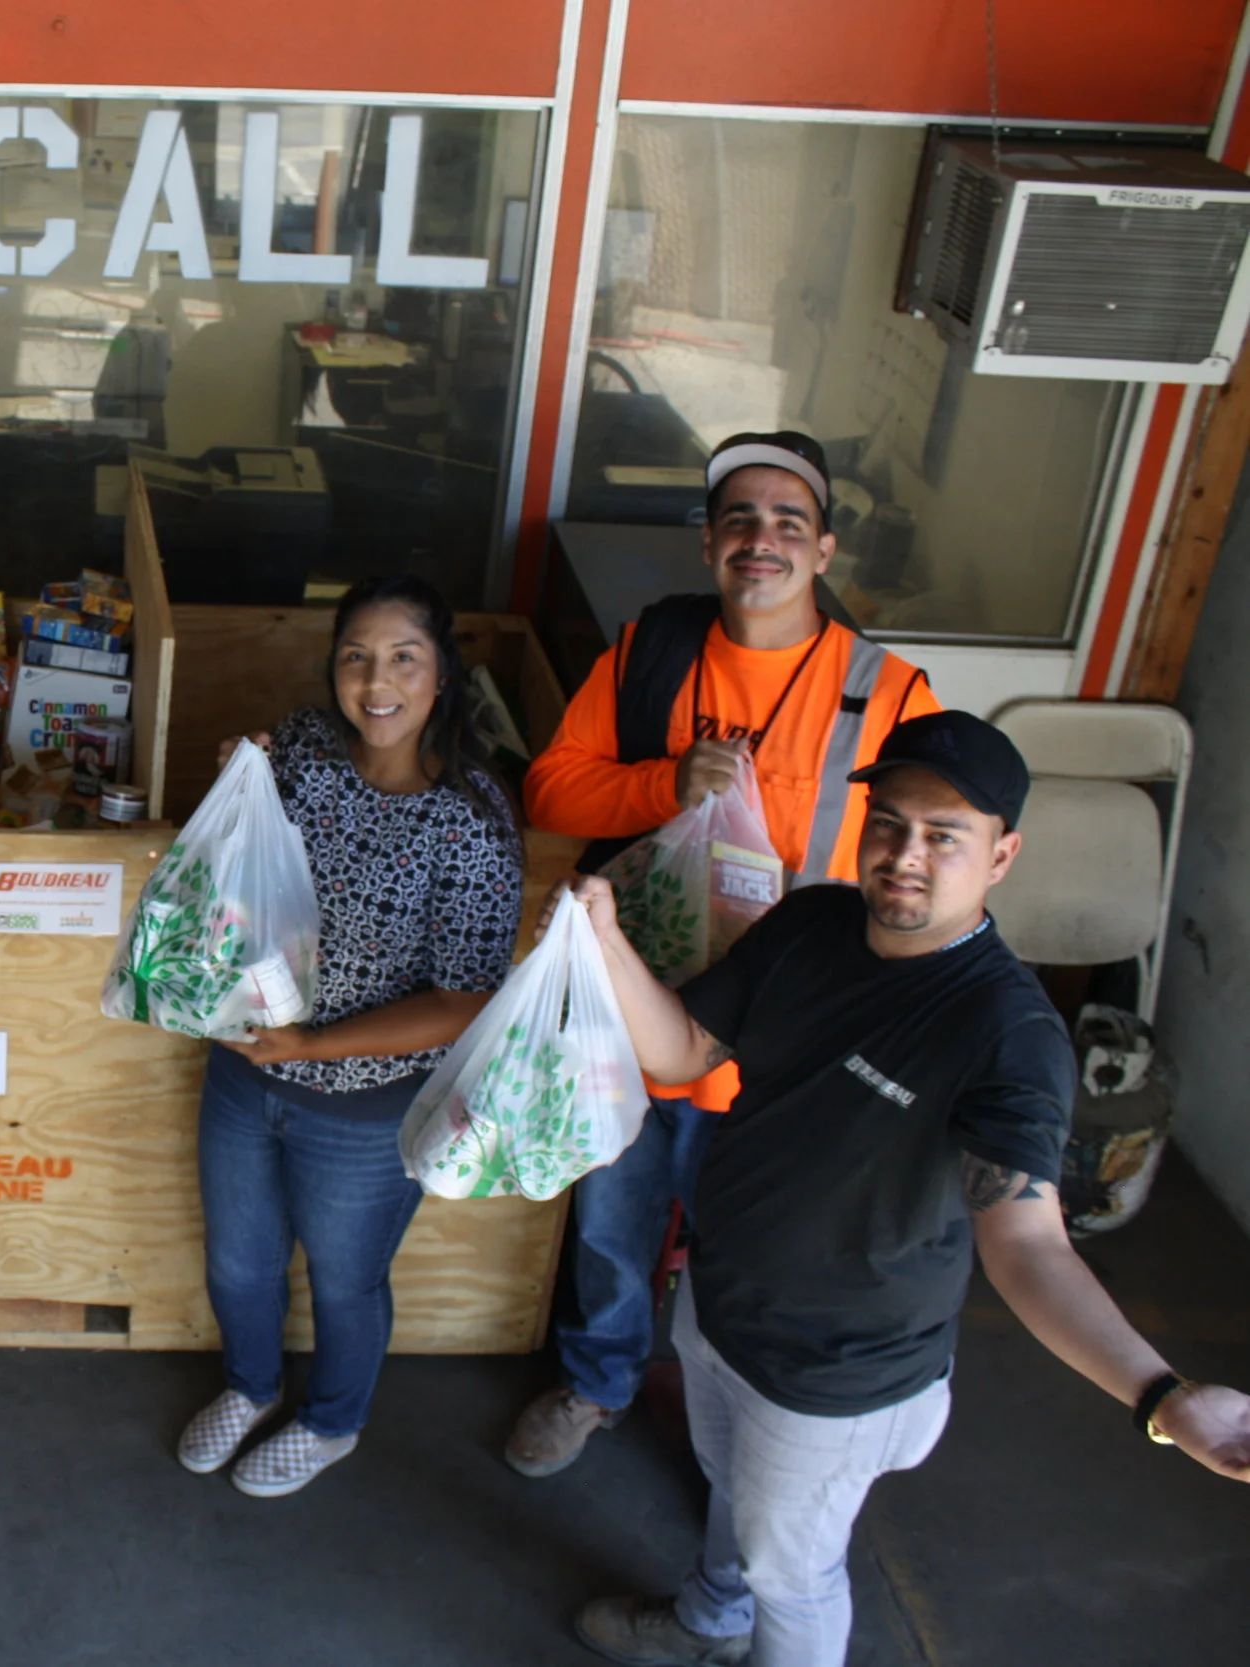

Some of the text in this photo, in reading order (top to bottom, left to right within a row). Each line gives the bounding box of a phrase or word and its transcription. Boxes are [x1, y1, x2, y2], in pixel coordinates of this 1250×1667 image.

[1108, 189, 1194, 208] FRIGIDAIRE
[29, 697, 108, 717] Cinnamon
[720, 875, 775, 905] JACK
